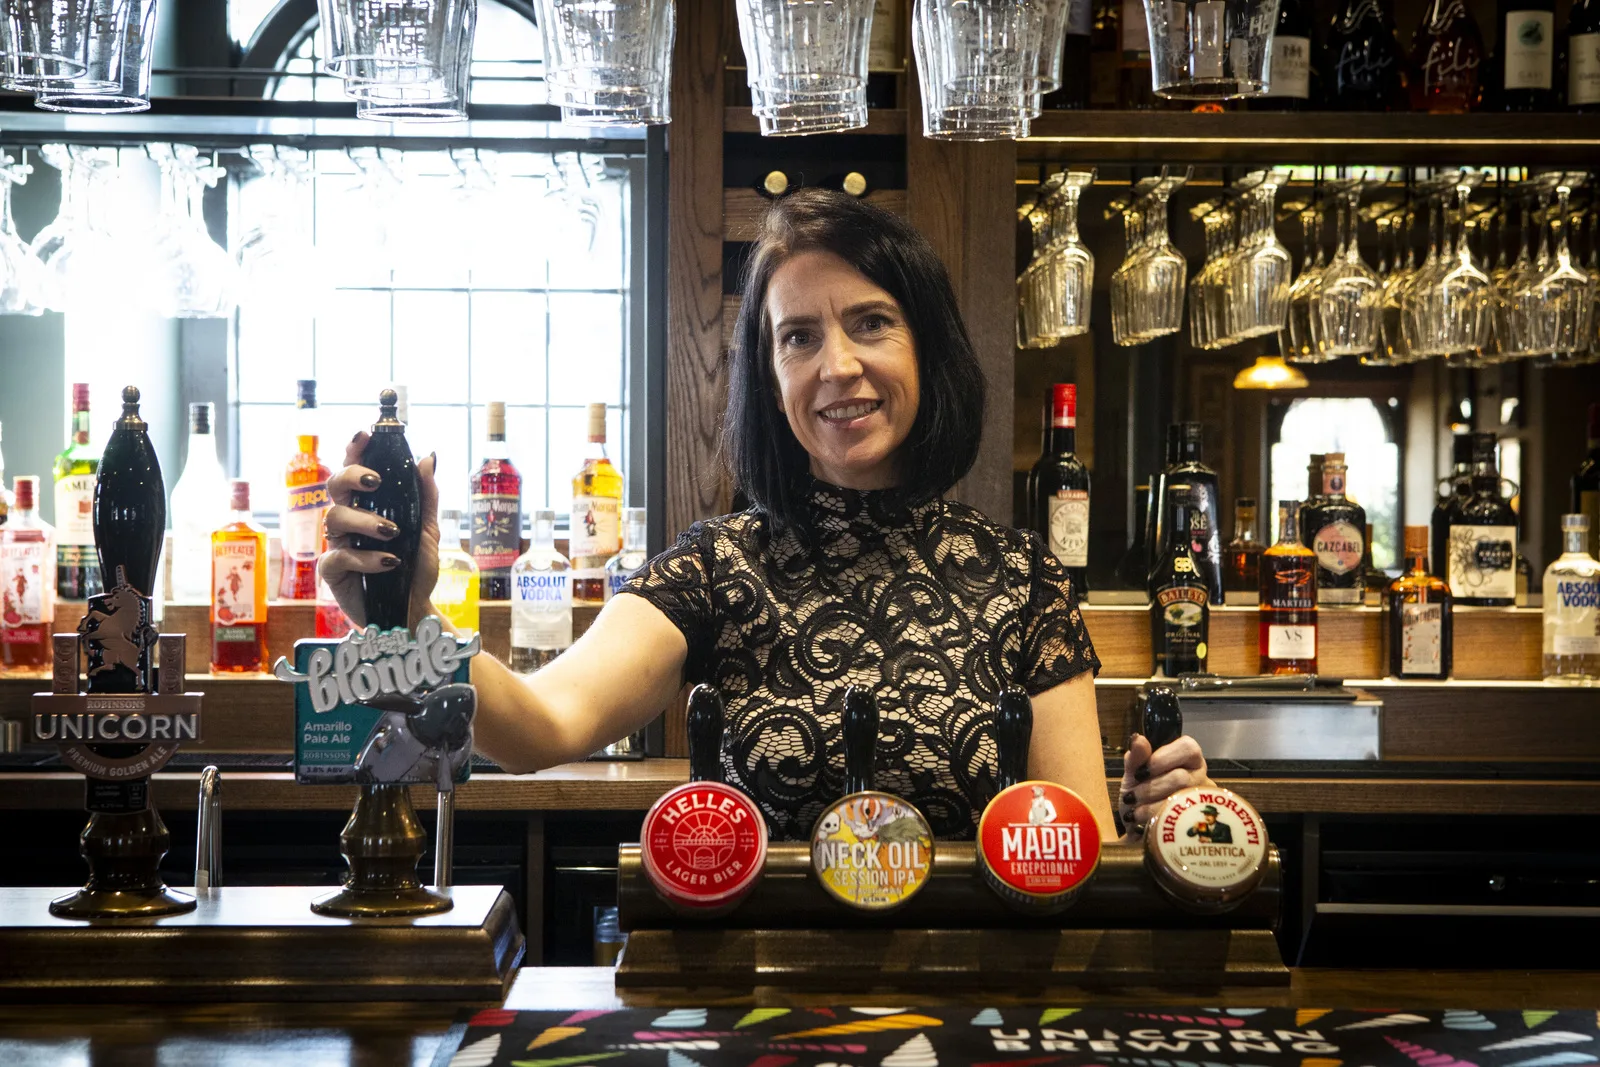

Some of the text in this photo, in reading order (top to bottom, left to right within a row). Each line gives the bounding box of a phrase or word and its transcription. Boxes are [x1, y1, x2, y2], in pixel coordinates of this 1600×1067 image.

[288, 489, 329, 509] PEROL
[1317, 541, 1360, 553] CAZCABEL
[517, 575, 567, 588] ABSOLUT
[521, 589, 562, 600] VODKA
[1161, 588, 1204, 603] BAILEYS
[1273, 599, 1312, 607] MARTELL
[1285, 629, 1302, 640] VS
[273, 615, 481, 714] blonde
[87, 699, 146, 709] ROBINSONS
[35, 713, 198, 740] UNICORN
[303, 721, 352, 732] Amarillo
[303, 733, 351, 744] Pale Ale
[66, 745, 168, 777] PREMIUM GOLDEN ALE
[303, 751, 351, 760] ROBINSONS
[661, 793, 748, 825] HELLES
[1163, 793, 1260, 845] BIRRA MORETTI
[1001, 822, 1082, 861] MADRÍ
[820, 841, 926, 870] NECK OIL
[1180, 846, 1246, 857] L'AUTENTICA
[665, 860, 743, 885] LAGER BIER
[1011, 861, 1075, 875] EXCEPCIONAL
[833, 869, 917, 886] SESSION IPA
[993, 1040, 1340, 1052] BREWING
